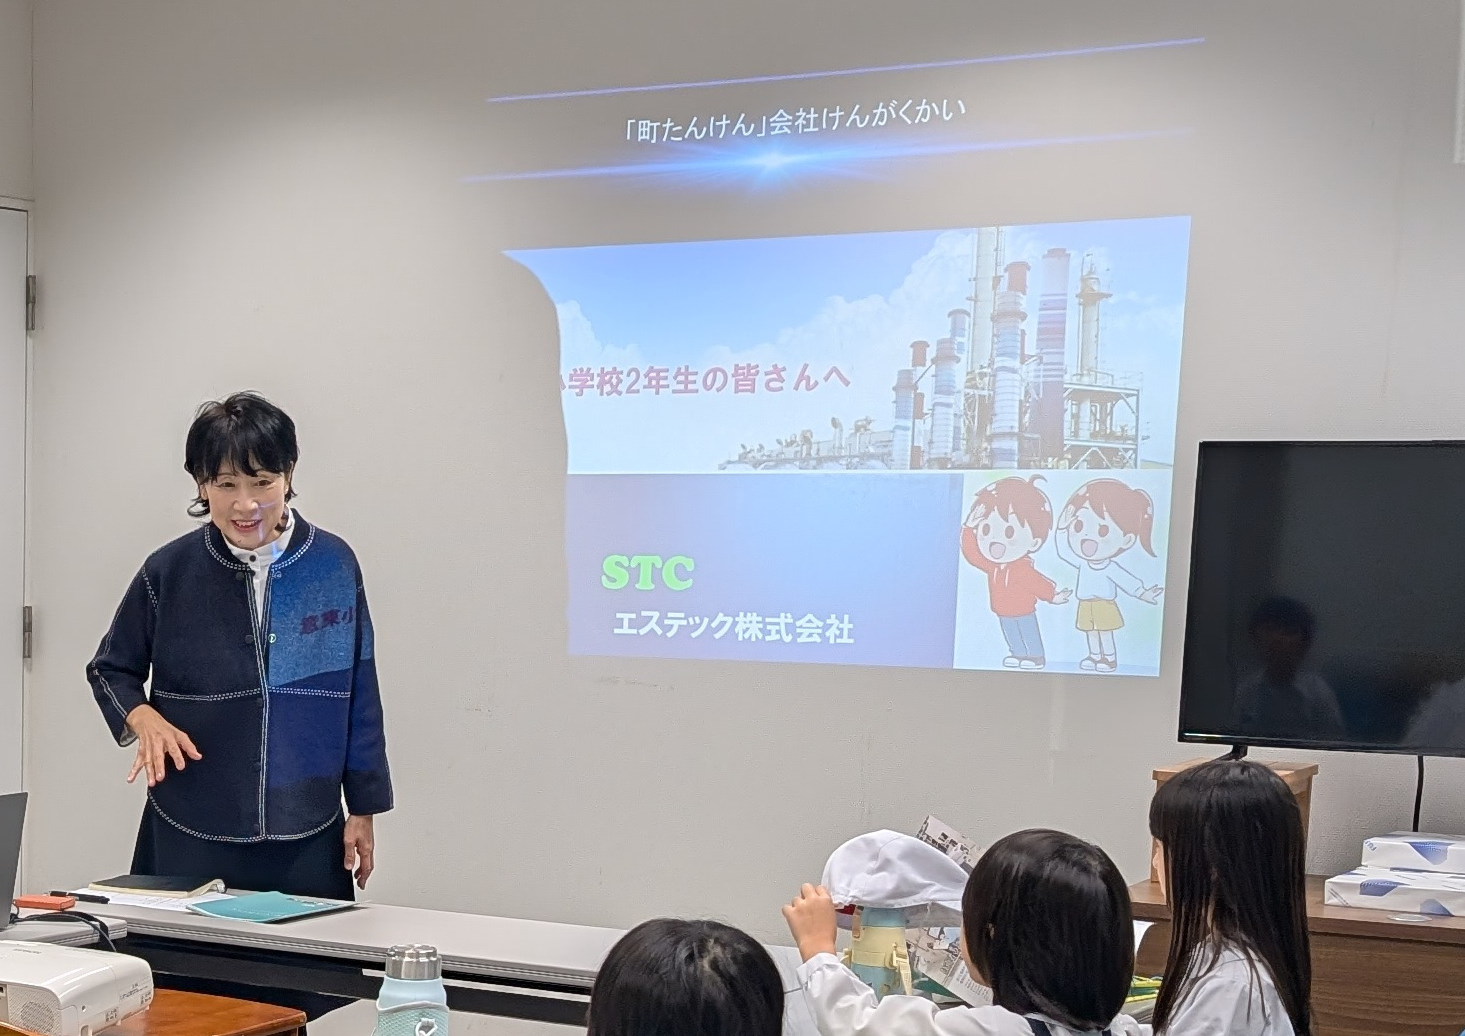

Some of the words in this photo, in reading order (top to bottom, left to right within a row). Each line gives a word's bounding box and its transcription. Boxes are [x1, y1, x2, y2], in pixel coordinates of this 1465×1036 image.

[626, 98, 966, 144] 「町たんけん」会社けんがくかい
[560, 363, 851, 396] 学校2年生の皆さんへ
[601, 554, 695, 591] STC
[613, 610, 855, 644] エステック株式会社
